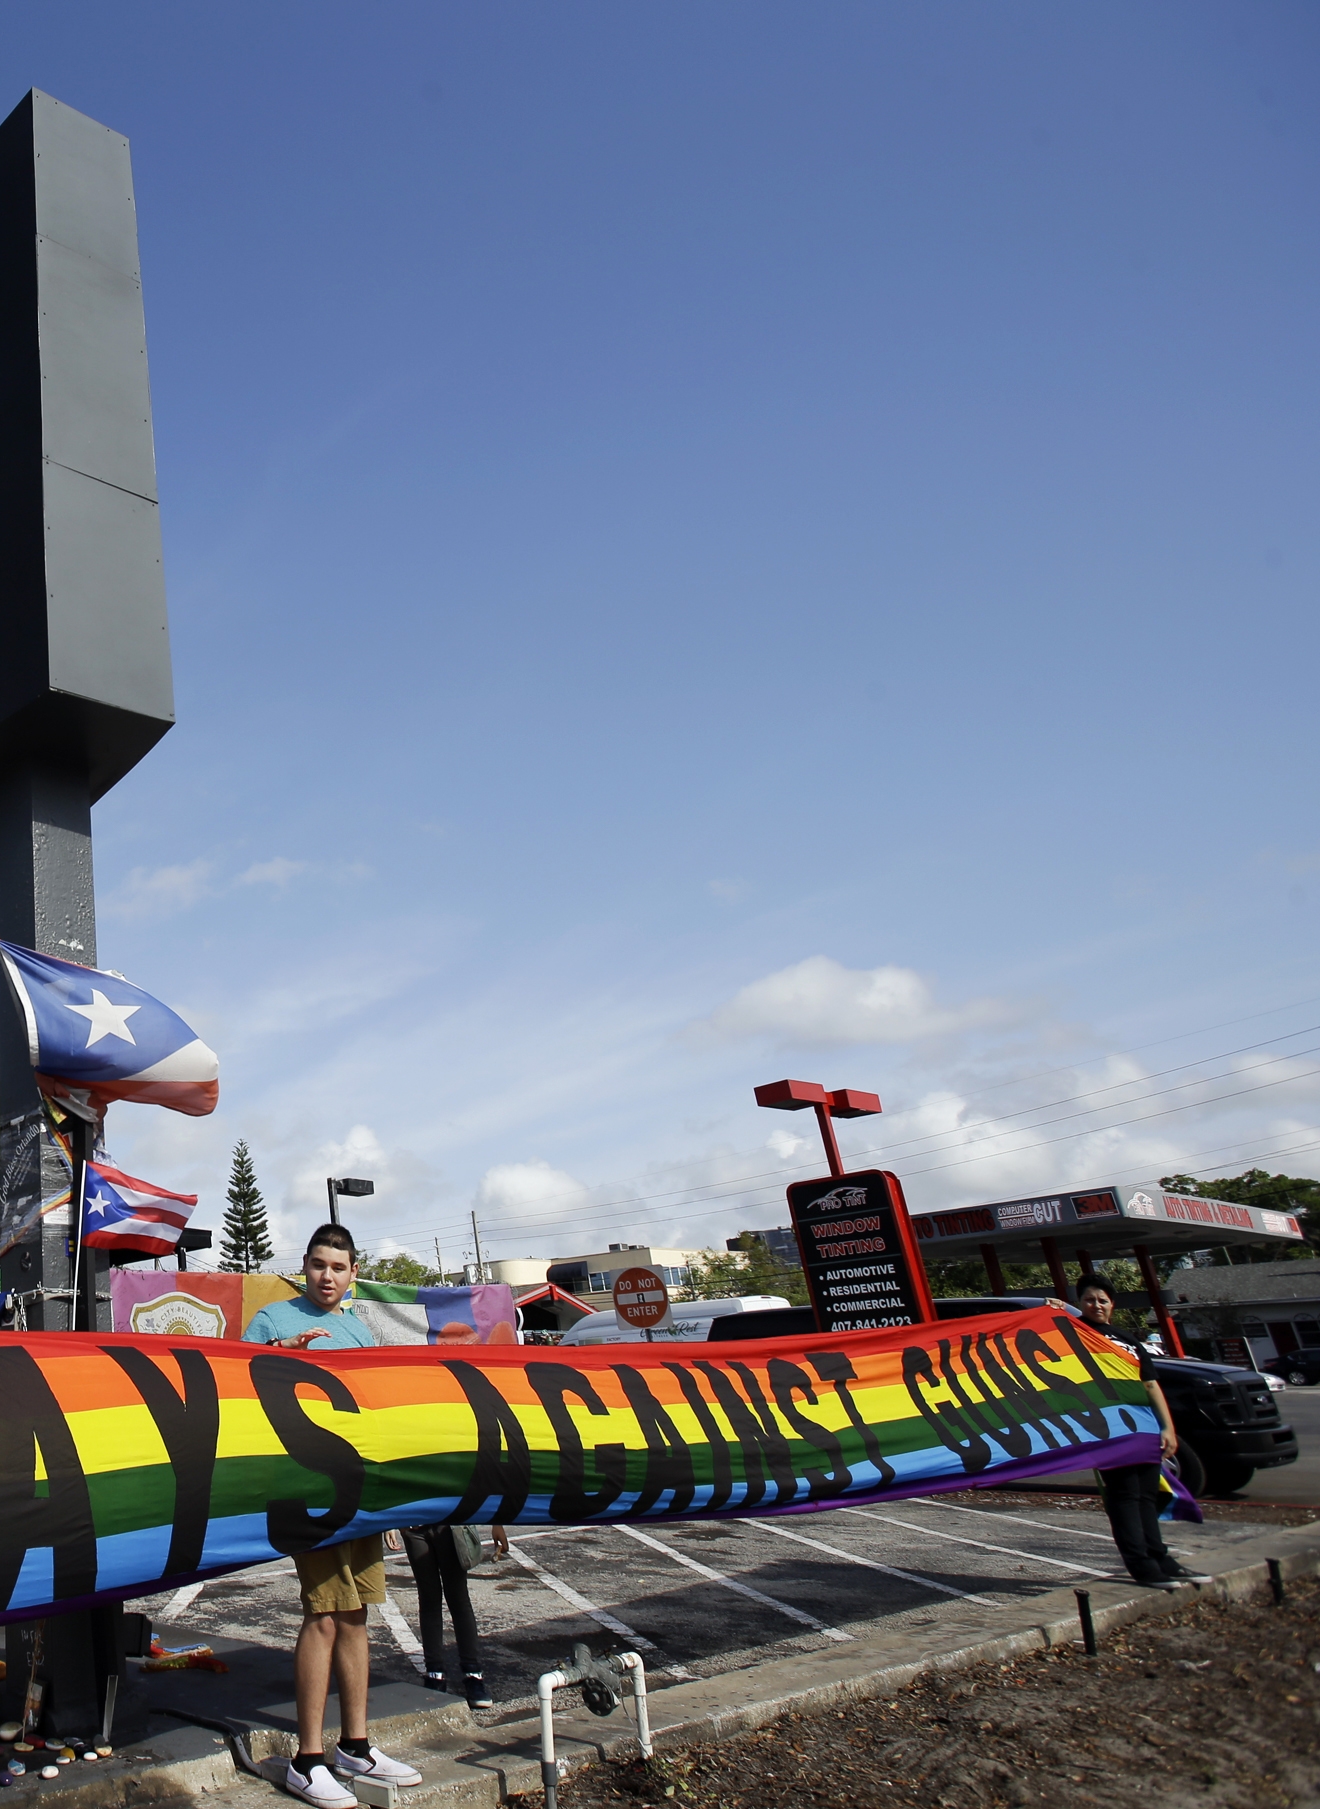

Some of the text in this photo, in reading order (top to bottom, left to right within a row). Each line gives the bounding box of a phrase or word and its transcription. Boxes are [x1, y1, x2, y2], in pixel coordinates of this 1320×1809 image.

[15, 1123, 40, 1156] Orlando
[820, 1193, 867, 1211] PRO TINT
[997, 1204, 1034, 1217] COMPUTER
[1076, 1193, 1114, 1213] 3M
[1034, 1200, 1061, 1224] CUT
[810, 1216, 880, 1239] WINDOW
[933, 1208, 996, 1237] TINTING
[816, 1237, 886, 1258] TINTING
[826, 1263, 896, 1281] AUTOMOTIVE
[618, 1277, 656, 1291] DO NOT
[829, 1280, 900, 1297] RESIDENTIAL
[160, 1307, 176, 1321] CITY
[627, 1305, 658, 1318] ENTER
[833, 1297, 905, 1313] COMMERCIAL
[675, 1320, 700, 1337] Rest
[831, 1315, 912, 1332] 407-841-2123
[437, 1351, 895, 1525] AGAINST
[902, 1316, 1139, 1474] GUNS!
